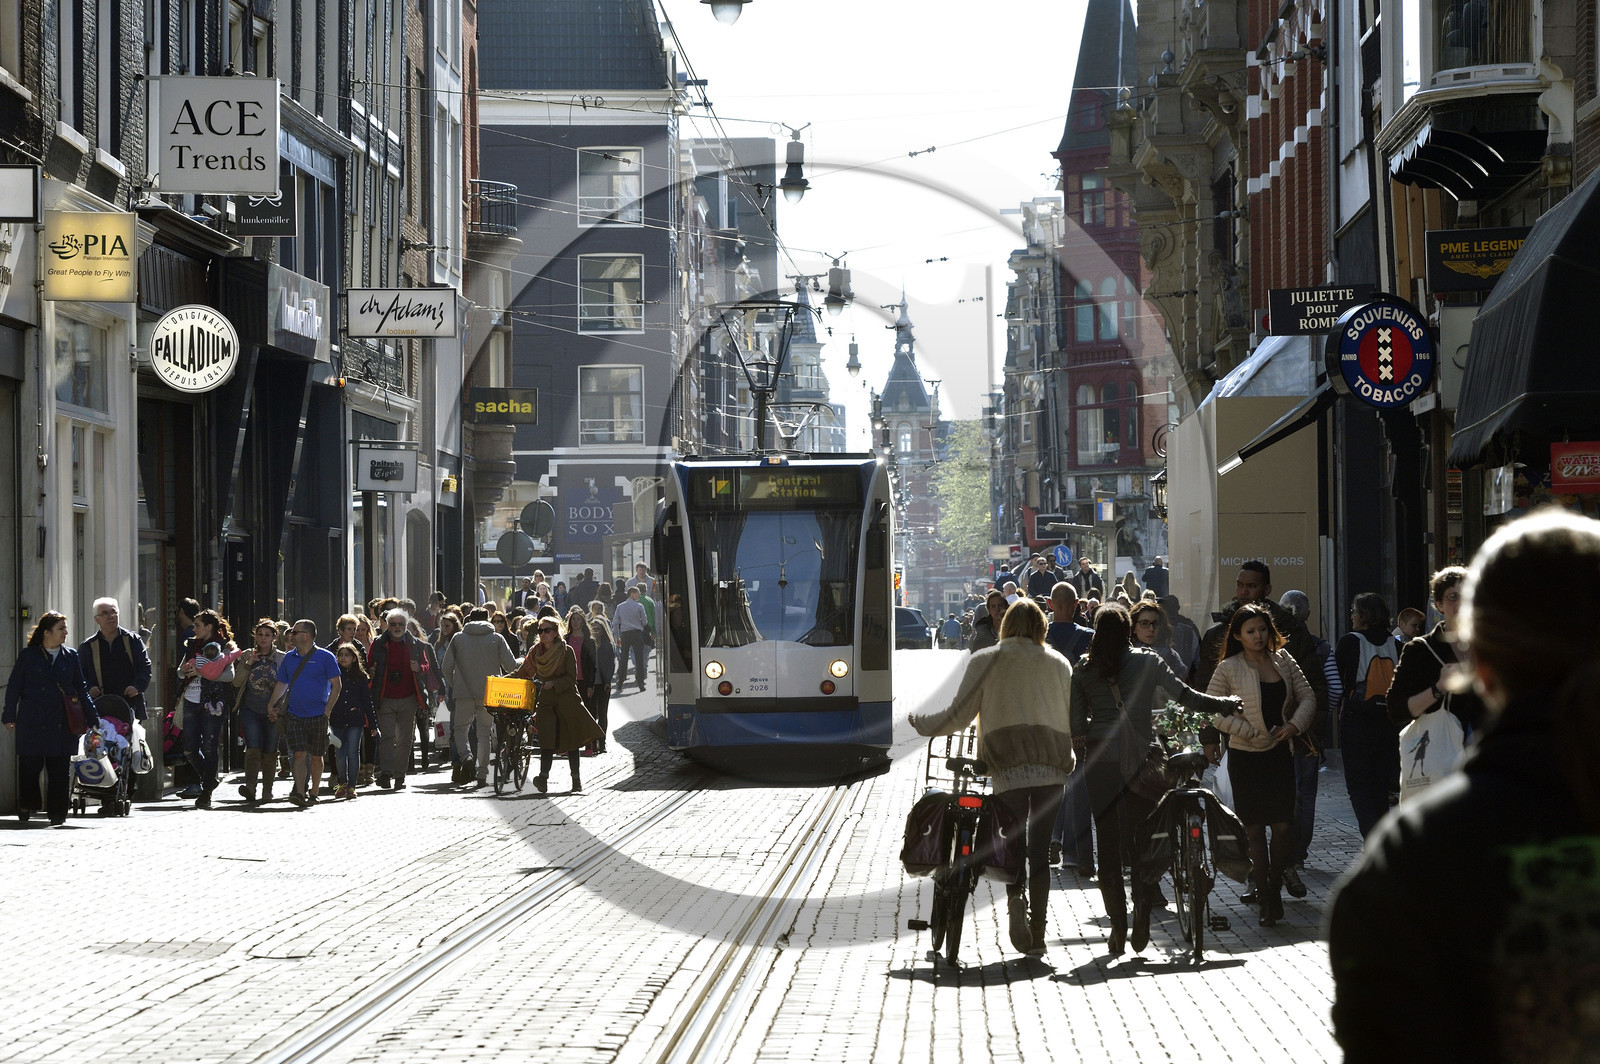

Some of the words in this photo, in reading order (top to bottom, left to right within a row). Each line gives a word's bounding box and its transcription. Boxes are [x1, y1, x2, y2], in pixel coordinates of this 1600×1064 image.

[170, 99, 266, 137] ACE
[169, 145, 266, 171] Trends
[240, 215, 290, 224] hunkemöller
[84, 234, 129, 256] PIA
[1440, 242, 1470, 254] PME
[47, 268, 67, 276] Great
[68, 269, 92, 277] People
[1291, 289, 1355, 306] JULIETTE
[360, 294, 385, 315] dr.
[375, 293, 444, 334] Adam's
[1306, 304, 1339, 317] pour
[162, 311, 225, 334] L'ORIGINALE
[1347, 306, 1424, 341] SOUVENIRS
[155, 325, 231, 374] PALLADIUM
[163, 366, 197, 386] DEPUIS
[203, 365, 223, 383] 1947
[1353, 373, 1423, 403] TOBACCO
[475, 400, 533, 413] sacha
[1560, 455, 1600, 466] WAFE
[768, 475, 820, 486] Centraal
[772, 486, 817, 498] Station
[569, 506, 615, 522] BODY
[569, 523, 615, 536] SOX
[1274, 557, 1305, 566] KORS
